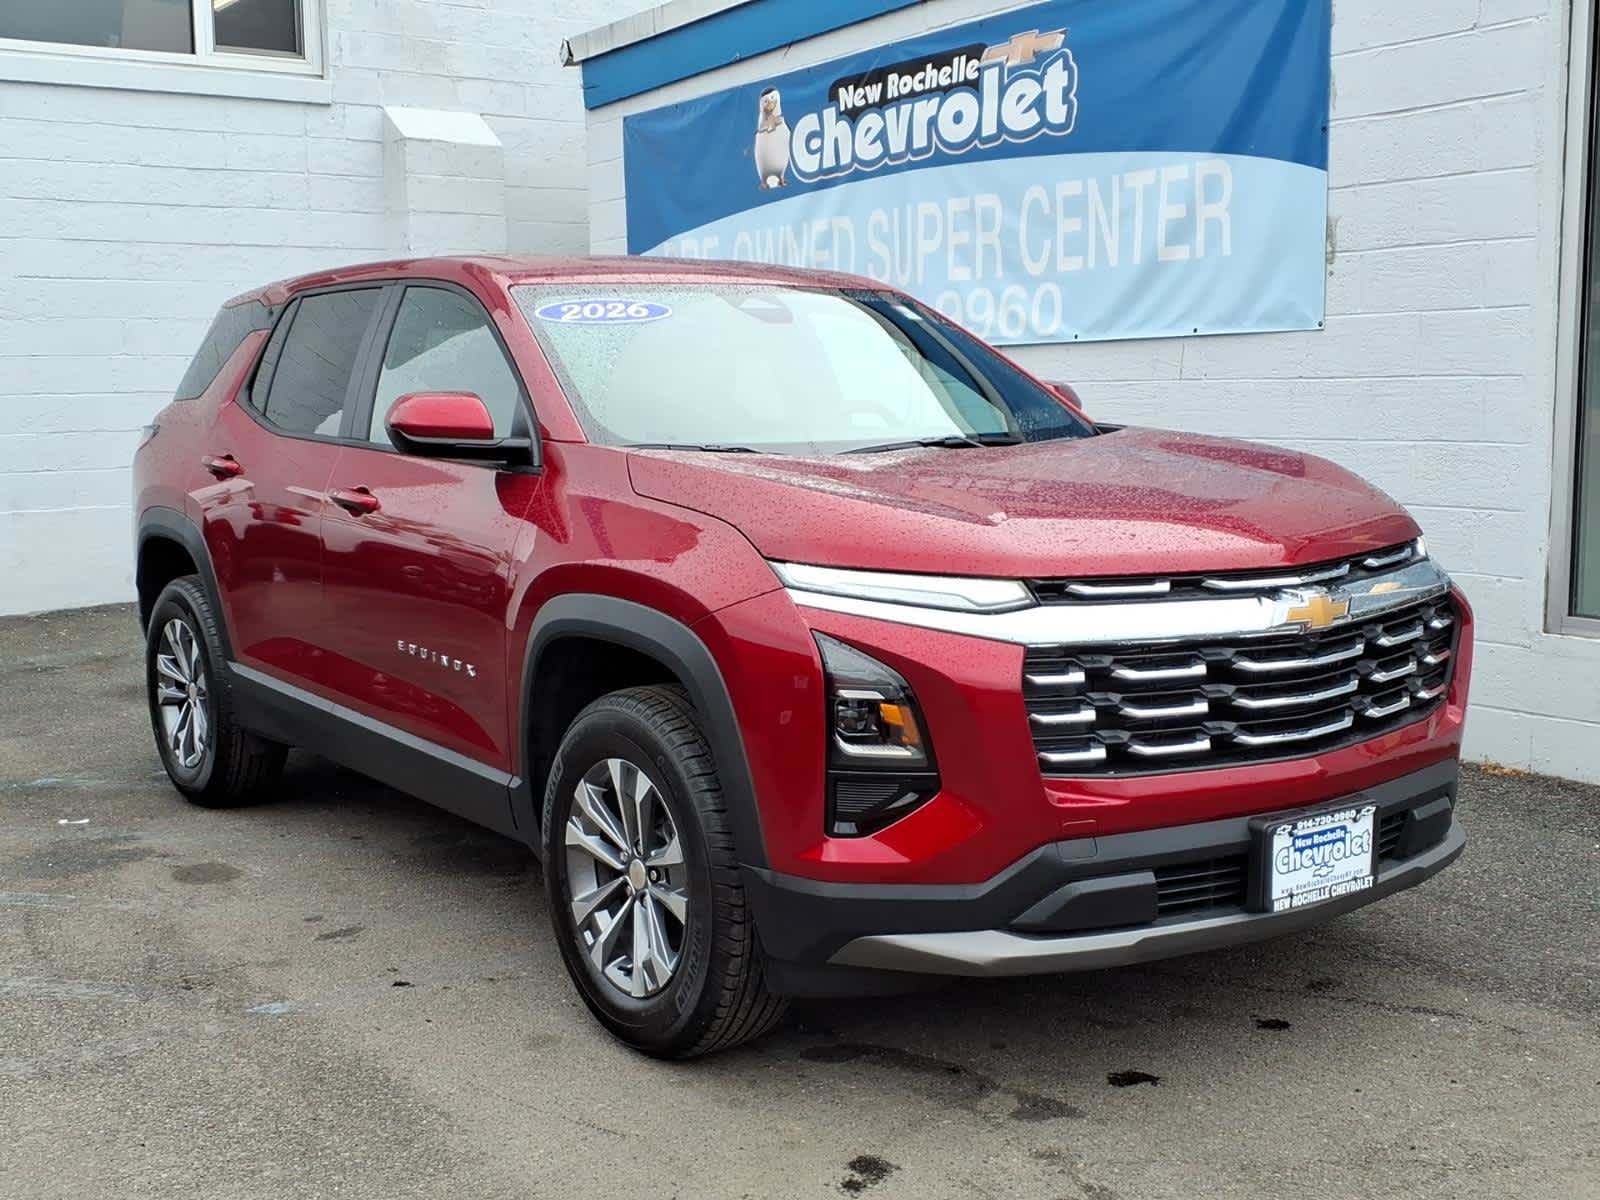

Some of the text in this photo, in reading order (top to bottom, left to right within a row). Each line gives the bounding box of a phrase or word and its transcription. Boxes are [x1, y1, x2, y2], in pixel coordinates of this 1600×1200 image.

[839, 55, 979, 112] New Rochelle
[792, 58, 1069, 173] Chevrolet
[866, 193, 1003, 285] SUPER
[1019, 158, 1233, 276] CENTER
[560, 303, 649, 321] 2026
[397, 640, 477, 677] EQUINOX
[1275, 829, 1371, 874] Chevrolet
[1295, 828, 1346, 849] New Rochelle
[1274, 876, 1374, 912] NEW ROCHELLE CHEVROLET
